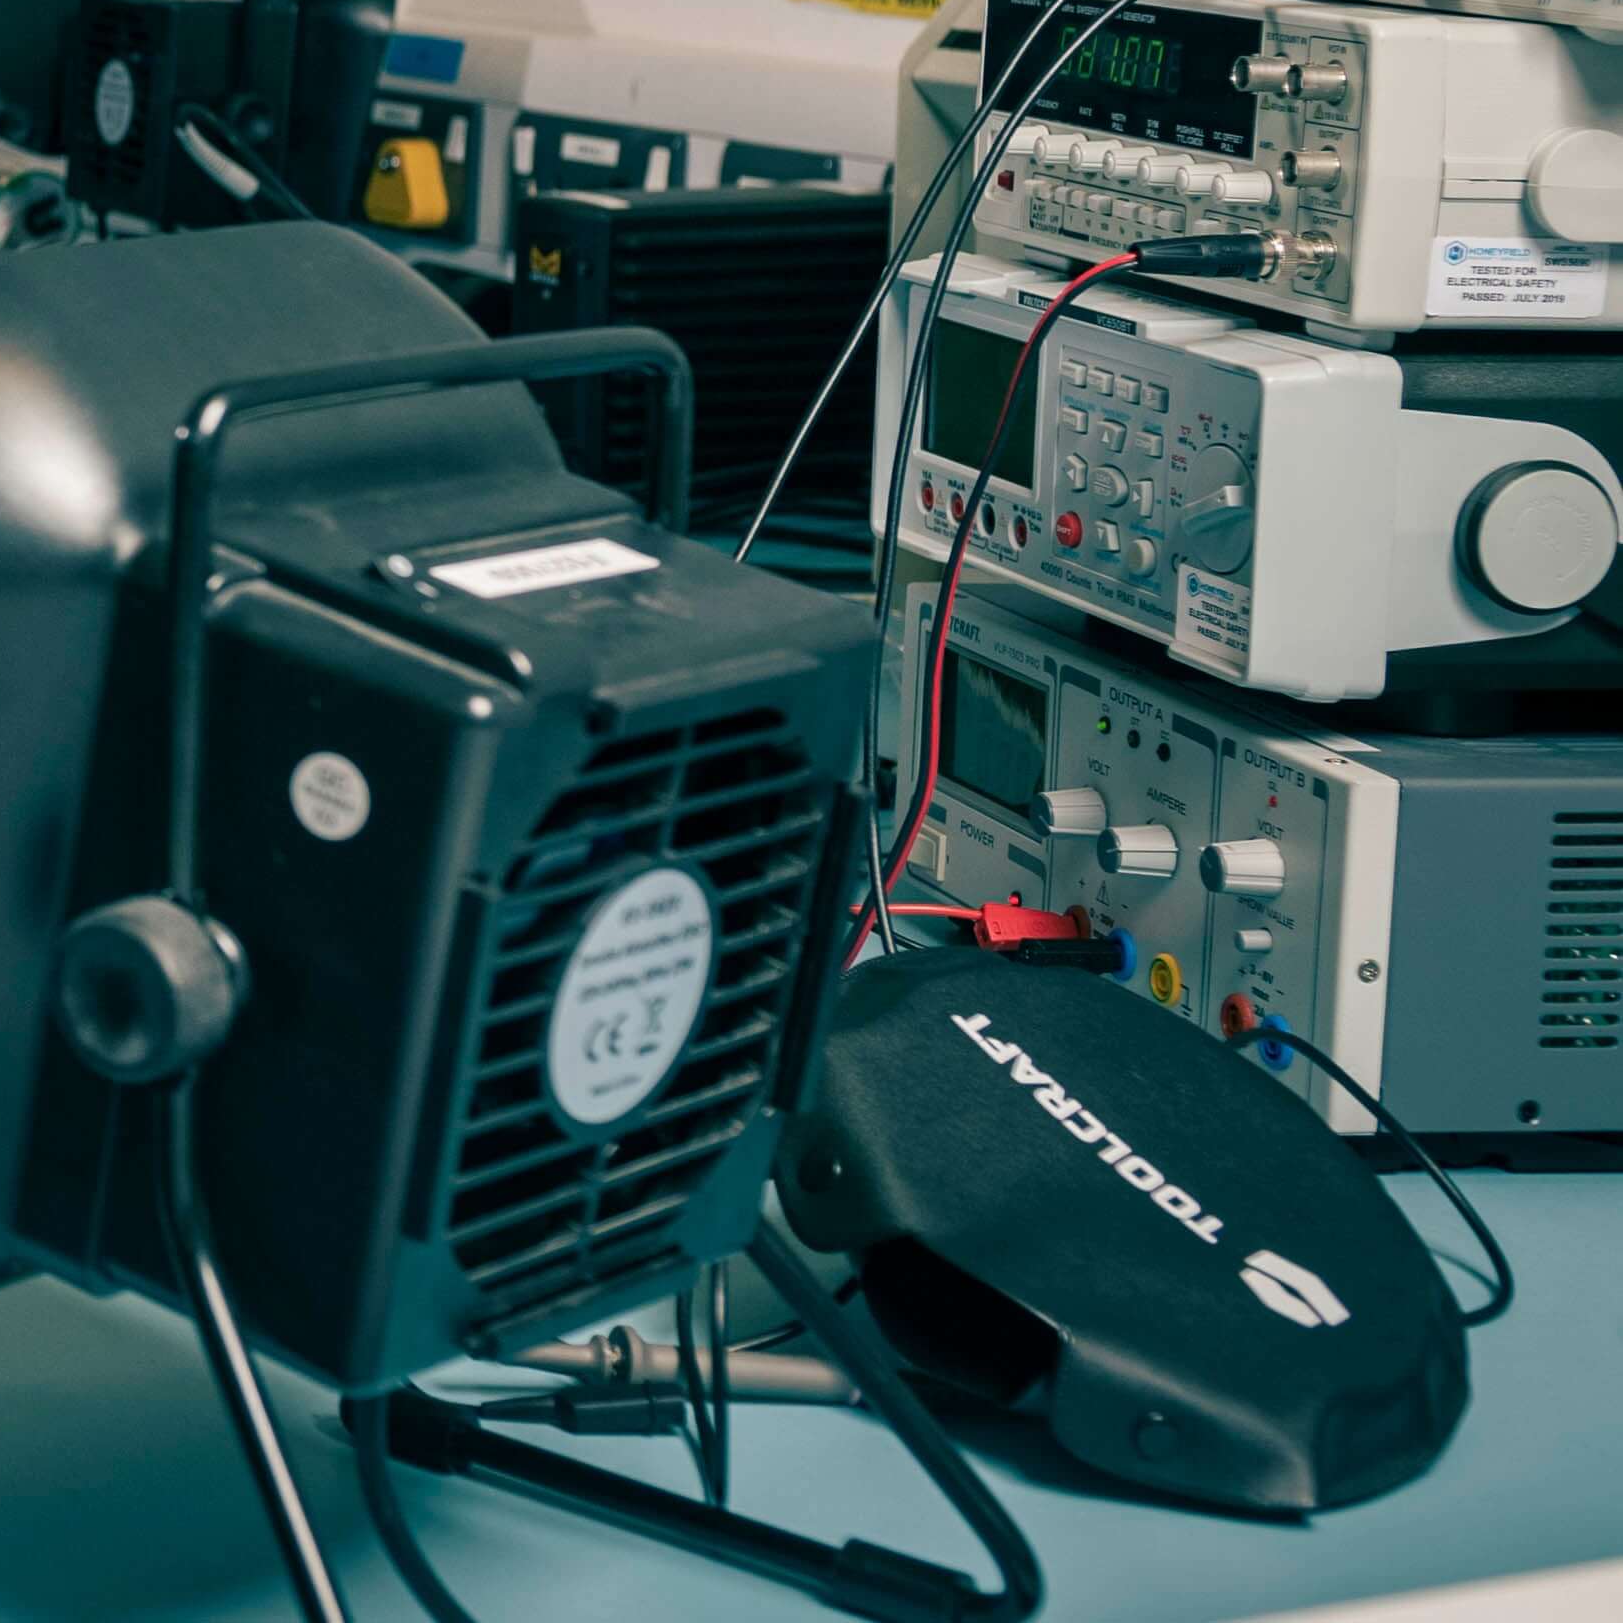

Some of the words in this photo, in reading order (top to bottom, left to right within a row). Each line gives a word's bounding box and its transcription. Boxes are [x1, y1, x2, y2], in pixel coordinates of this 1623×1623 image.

[1468, 247, 1531, 257] HONEYFIELD
[1447, 277, 1513, 287] ELECTRICAL
[1515, 278, 1559, 288] SAFETY
[1471, 266, 1513, 276] TESTED
[1515, 267, 1537, 276] FOR
[1513, 294, 1541, 303] JULY
[1065, 569, 1092, 591] Counts
[1096, 581, 1115, 600] True
[1116, 588, 1136, 607] RMS
[1189, 607, 1226, 630] ELECTRICAL
[1109, 686, 1153, 717] OUTPUT
[1155, 707, 1163, 723] A
[1088, 757, 1111, 777] VOLT
[1245, 749, 1295, 782] OUTPUT
[1296, 772, 1305, 788] B
[1146, 787, 1187, 816] AMPERE
[960, 819, 995, 849] POWER
[1258, 819, 1285, 841] VOLT
[1266, 908, 1295, 931] VALUE
[951, 1013, 1224, 1245] TOOLCRAFT
